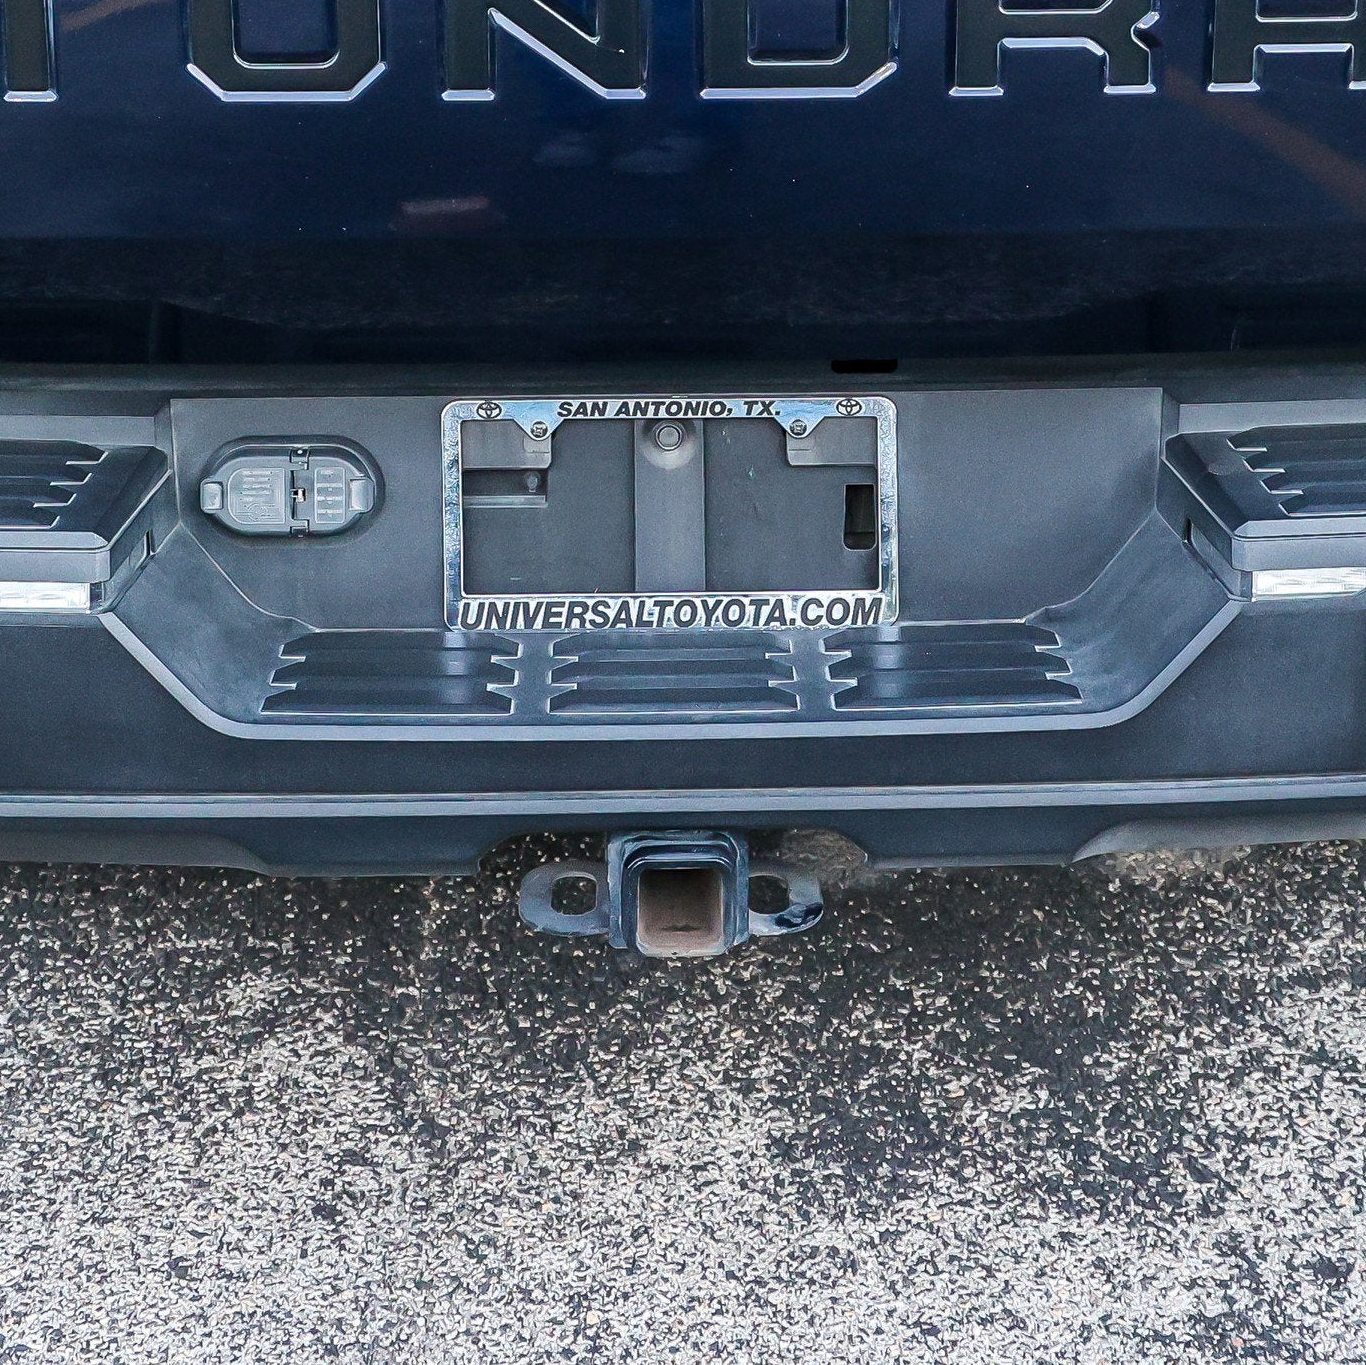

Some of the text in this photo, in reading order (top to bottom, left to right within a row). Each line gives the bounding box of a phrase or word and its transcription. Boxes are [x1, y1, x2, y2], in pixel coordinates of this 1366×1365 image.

[556, 399, 782, 418] SAN ANTONIO, TX.
[458, 596, 884, 630] UNIVERSALTOYOTA.COM
